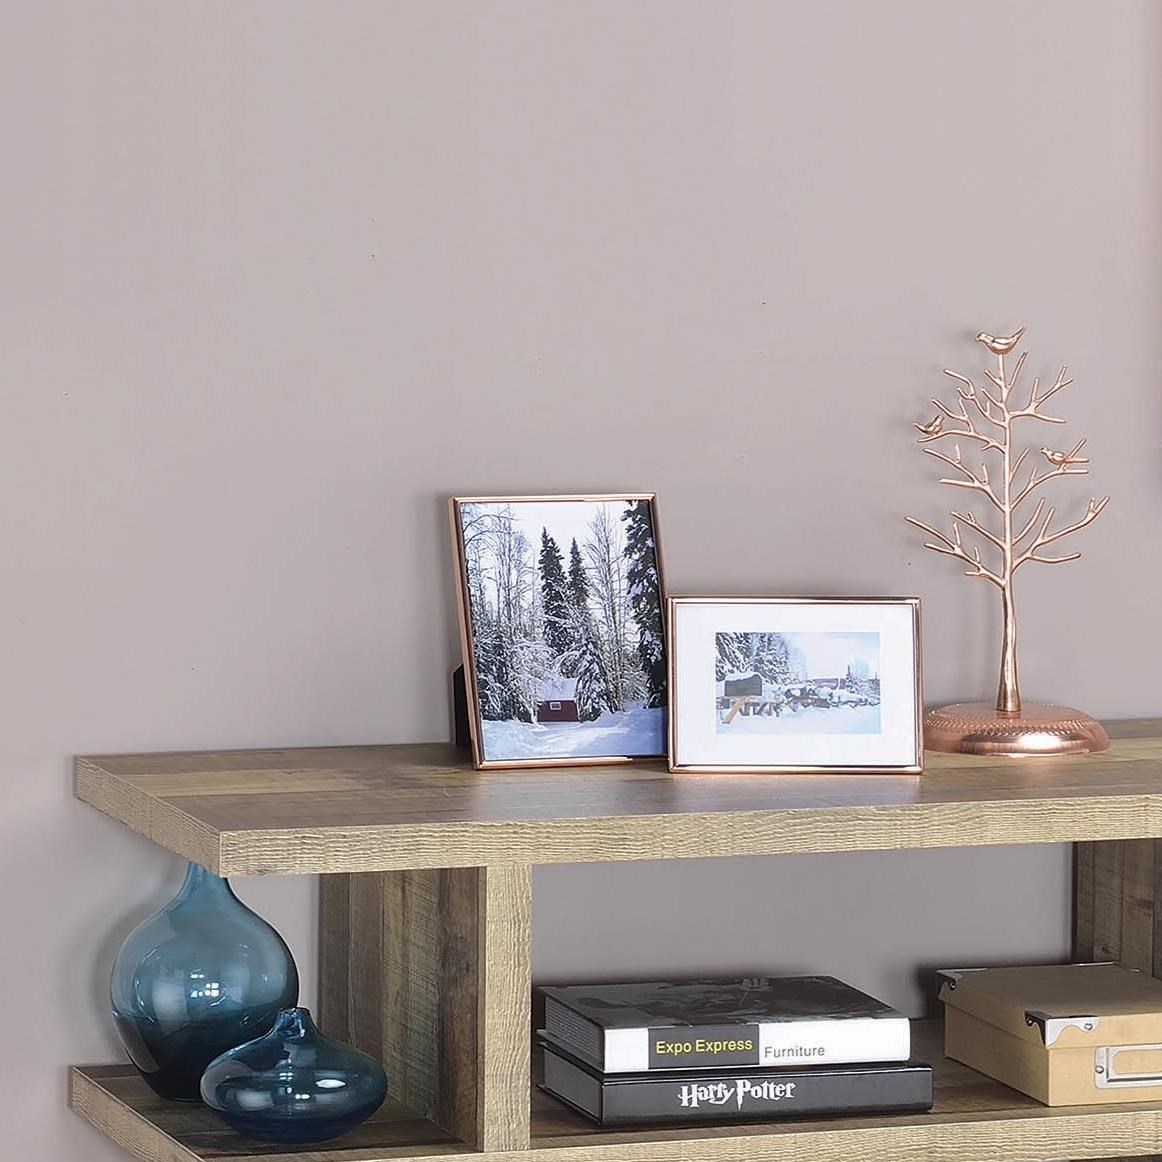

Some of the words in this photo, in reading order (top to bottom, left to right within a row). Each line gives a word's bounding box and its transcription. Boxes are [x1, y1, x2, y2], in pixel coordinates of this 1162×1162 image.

[656, 1040, 692, 1056] Expo
[695, 1038, 753, 1053] Express
[764, 1045, 826, 1059] Furniture
[678, 1082, 735, 1108] Harry
[736, 1079, 797, 1111] Potter
